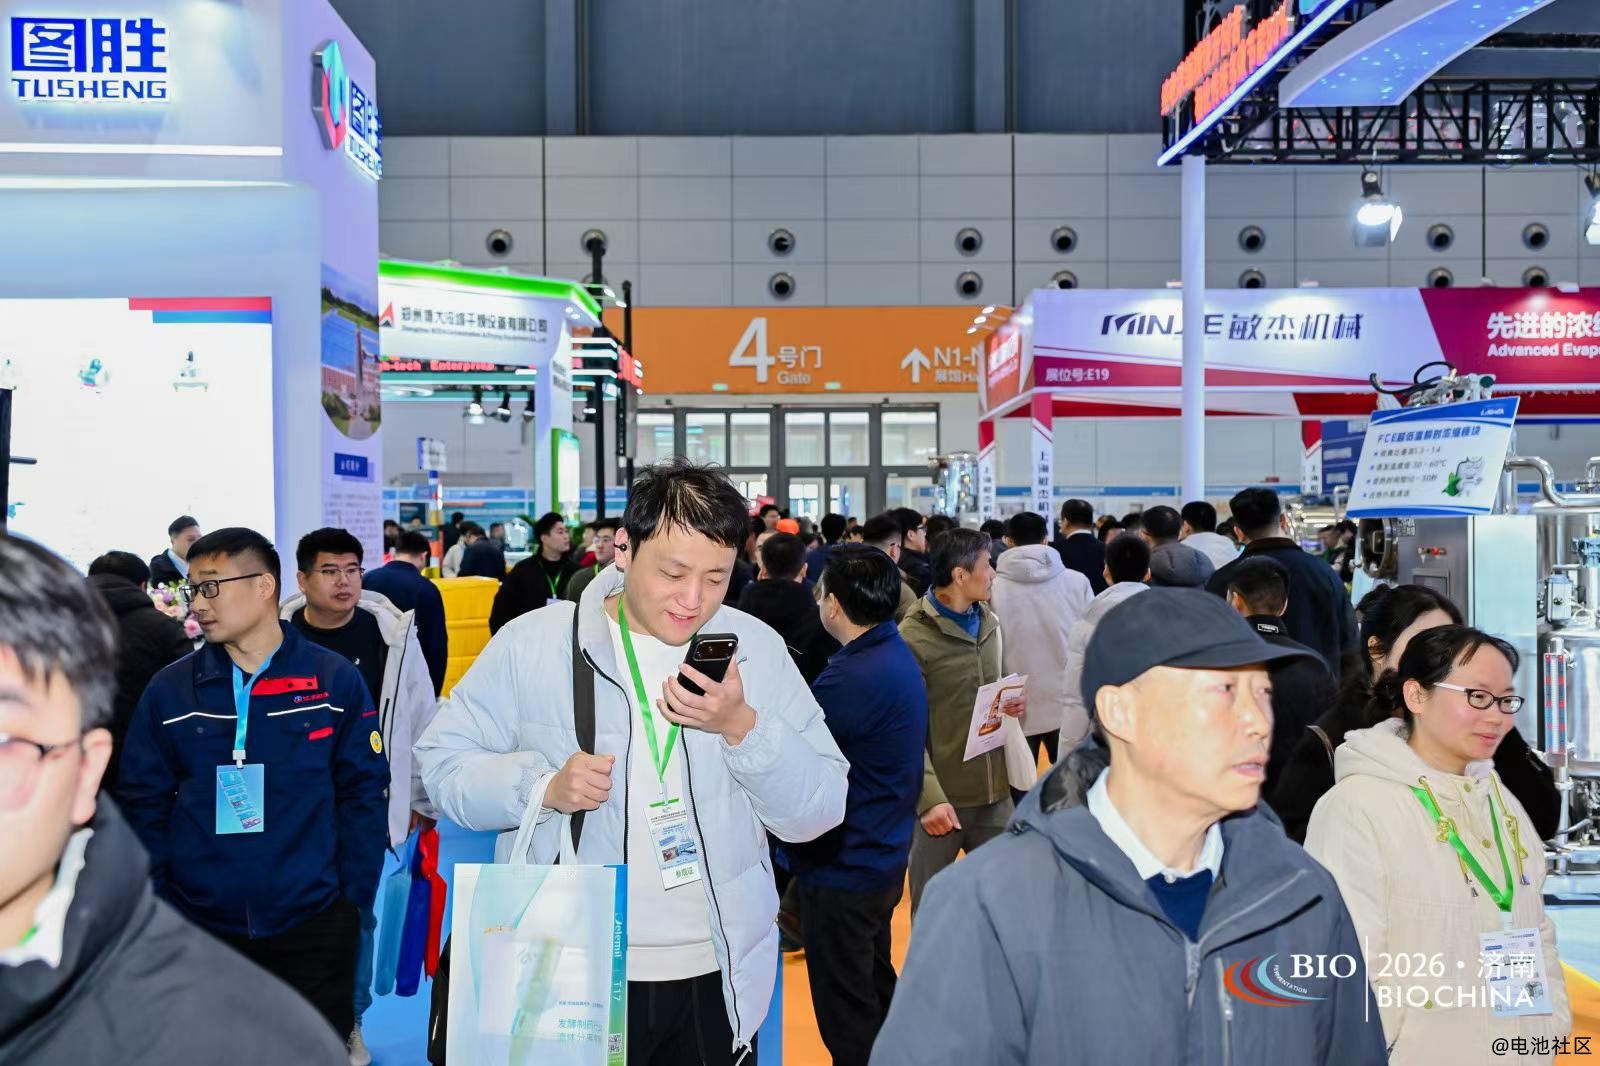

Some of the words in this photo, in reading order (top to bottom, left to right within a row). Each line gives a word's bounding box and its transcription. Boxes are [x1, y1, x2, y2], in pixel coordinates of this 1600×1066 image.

[11, 17, 167, 73] 图胜
[11, 78, 167, 99] TUSHENG
[1101, 312, 1224, 335] MINE
[1228, 313, 1364, 341] 敏杰机械
[728, 317, 776, 384] 4
[777, 345, 823, 369] 号门
[1488, 343, 1559, 357] Advanced
[777, 371, 811, 386] Gate
[1045, 367, 1110, 382] 展位号:E19
